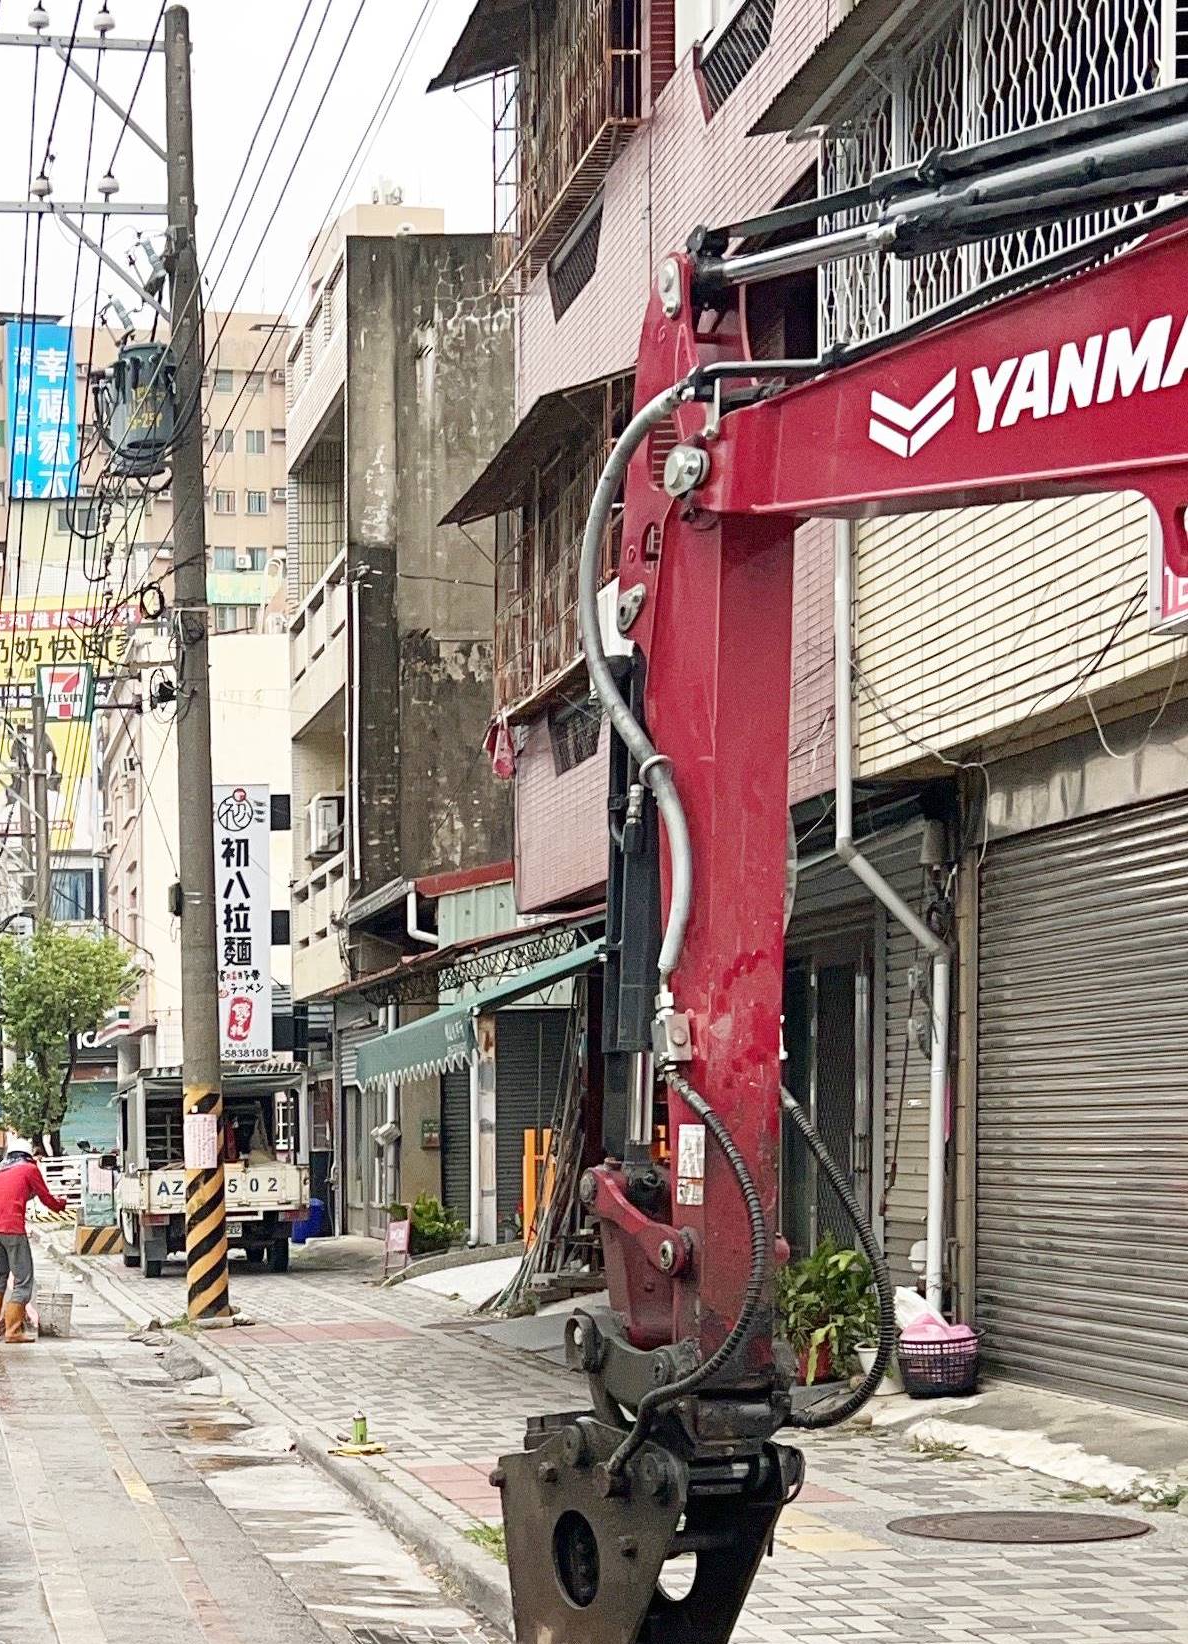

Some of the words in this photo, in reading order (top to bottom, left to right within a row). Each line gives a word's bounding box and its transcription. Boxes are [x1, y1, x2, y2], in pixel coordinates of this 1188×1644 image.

[221, 837, 252, 967] 初八拉麵
[230, 983, 264, 995] ラーメン
